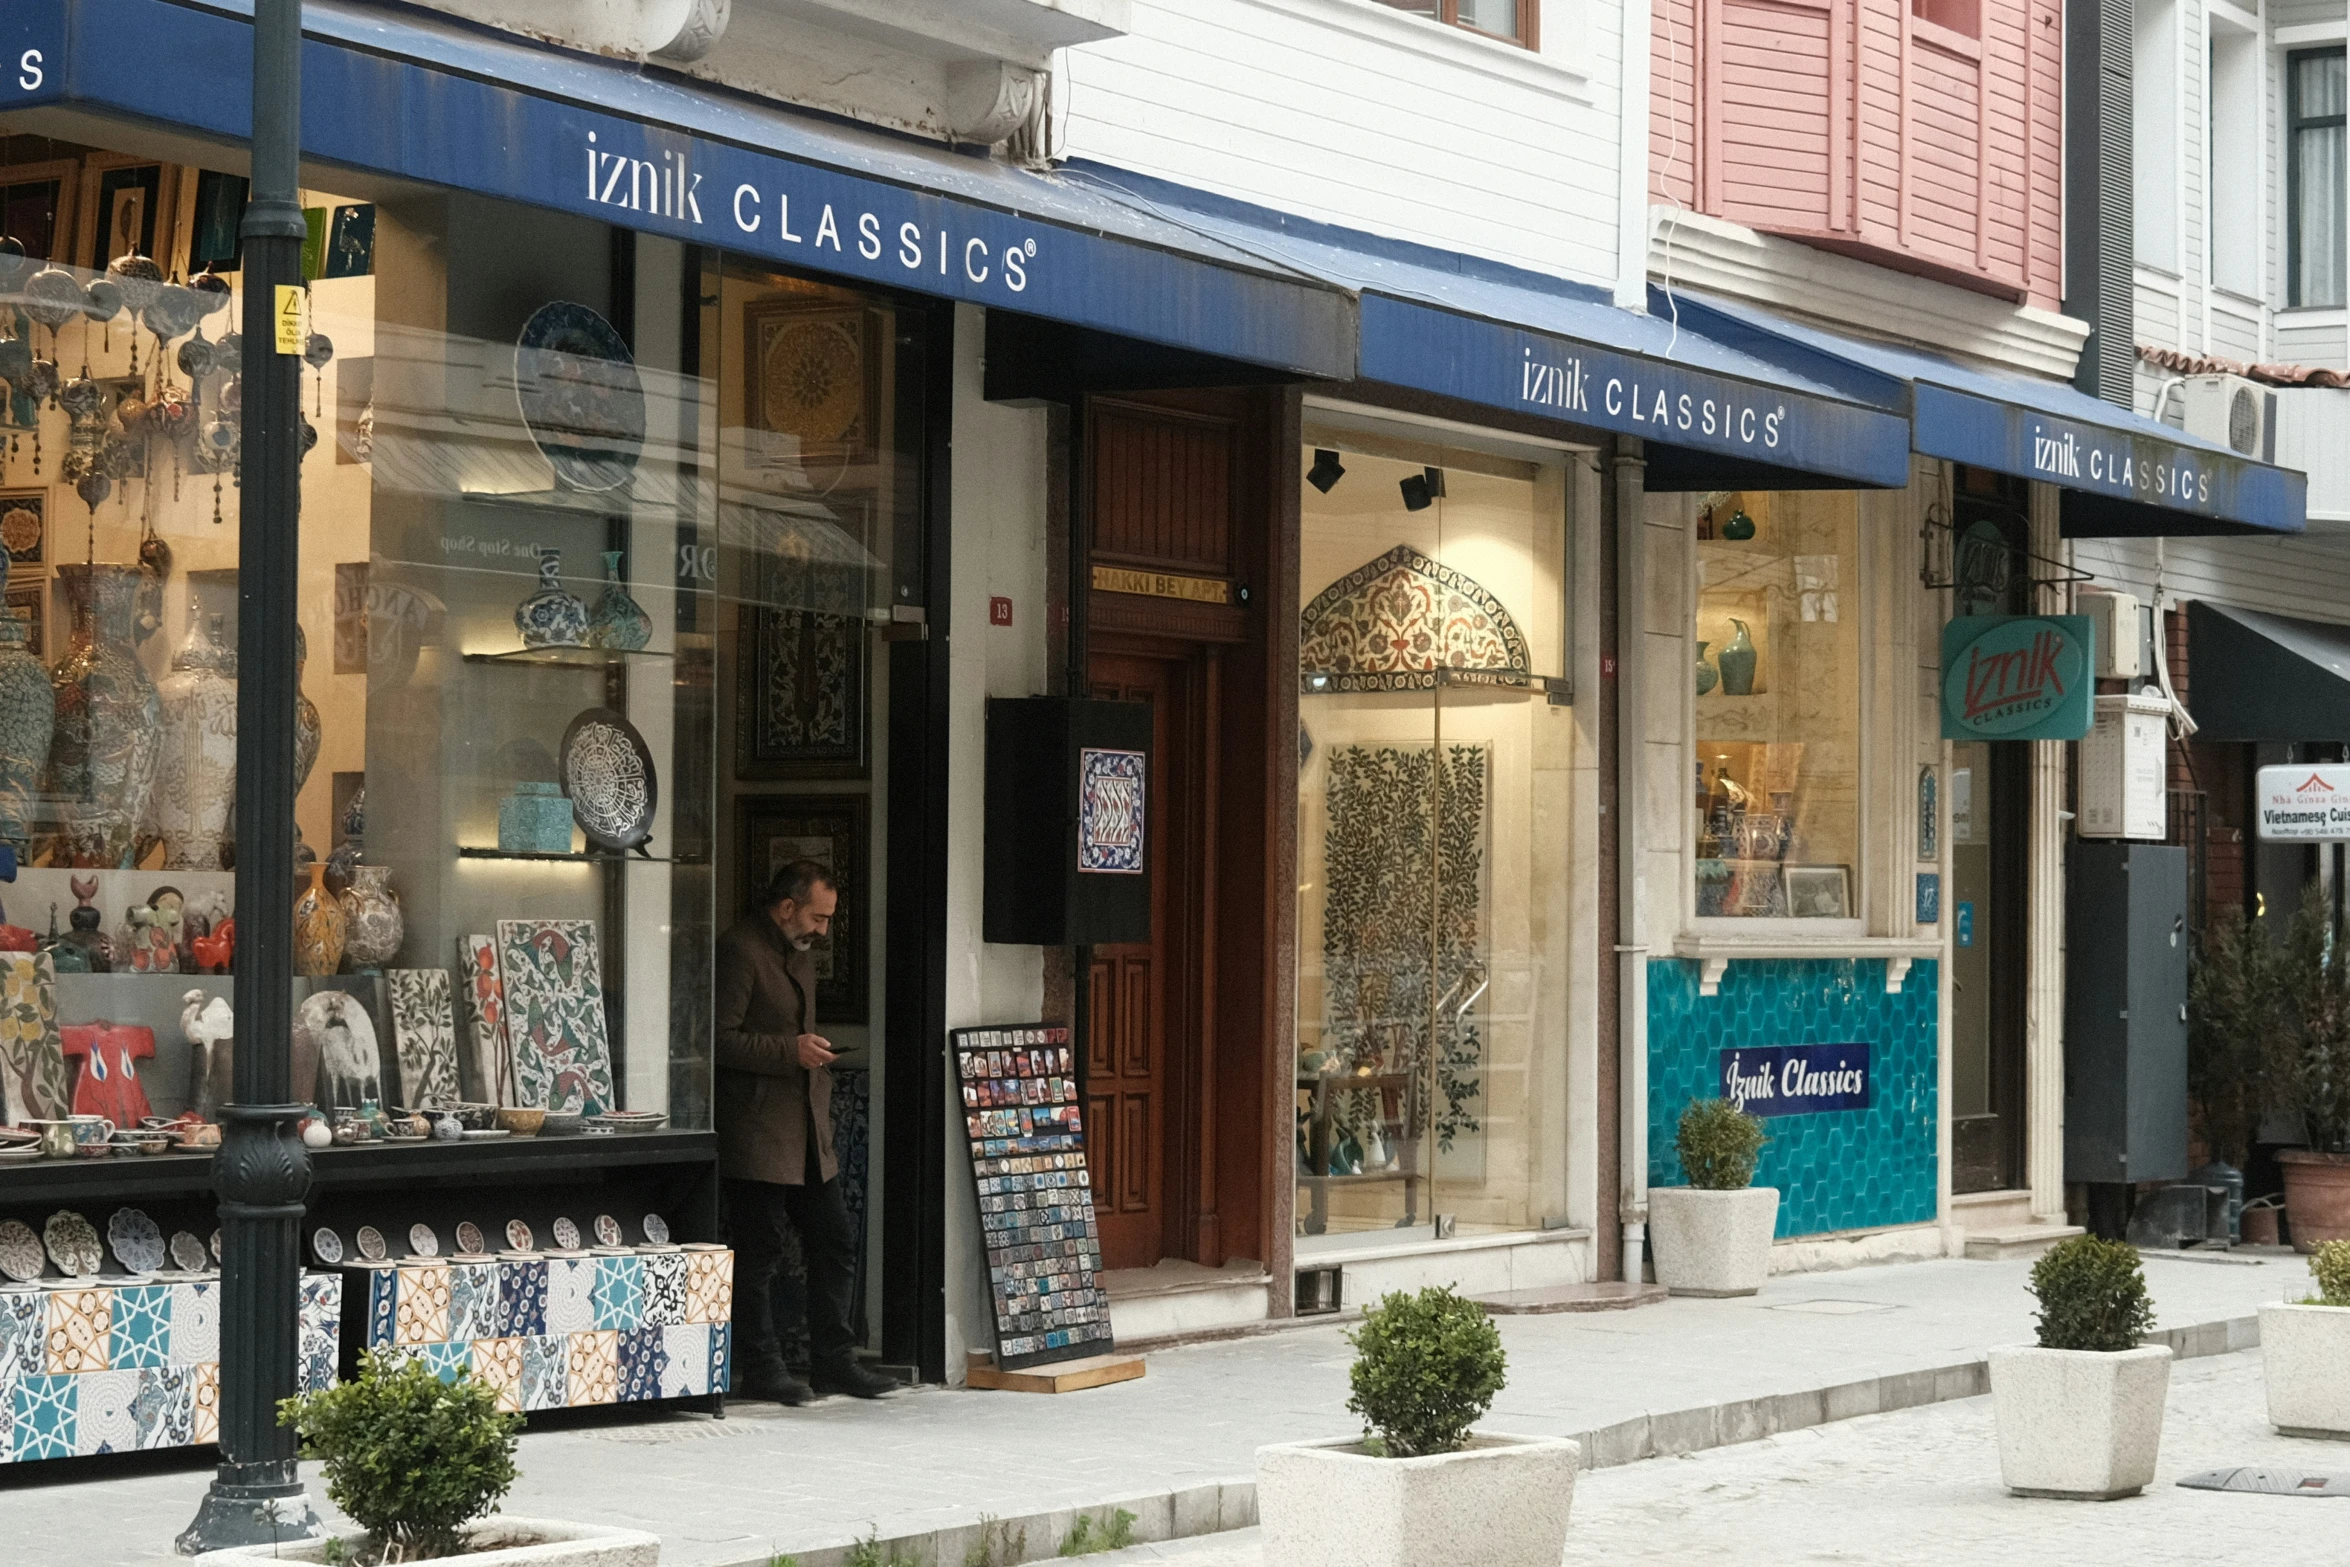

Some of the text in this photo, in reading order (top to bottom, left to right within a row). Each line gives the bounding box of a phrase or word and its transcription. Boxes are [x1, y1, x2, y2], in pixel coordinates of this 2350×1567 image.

[585, 131, 703, 224] iznik
[1521, 347, 1590, 412] iznik
[2035, 425, 2080, 478] iznik
[1098, 569, 1150, 593] HAKKI
[1155, 575, 1186, 597] BEY
[997, 603, 1008, 620] 13
[1973, 698, 2051, 726] CLASSICS
[1781, 1058, 1863, 1097] Classics
